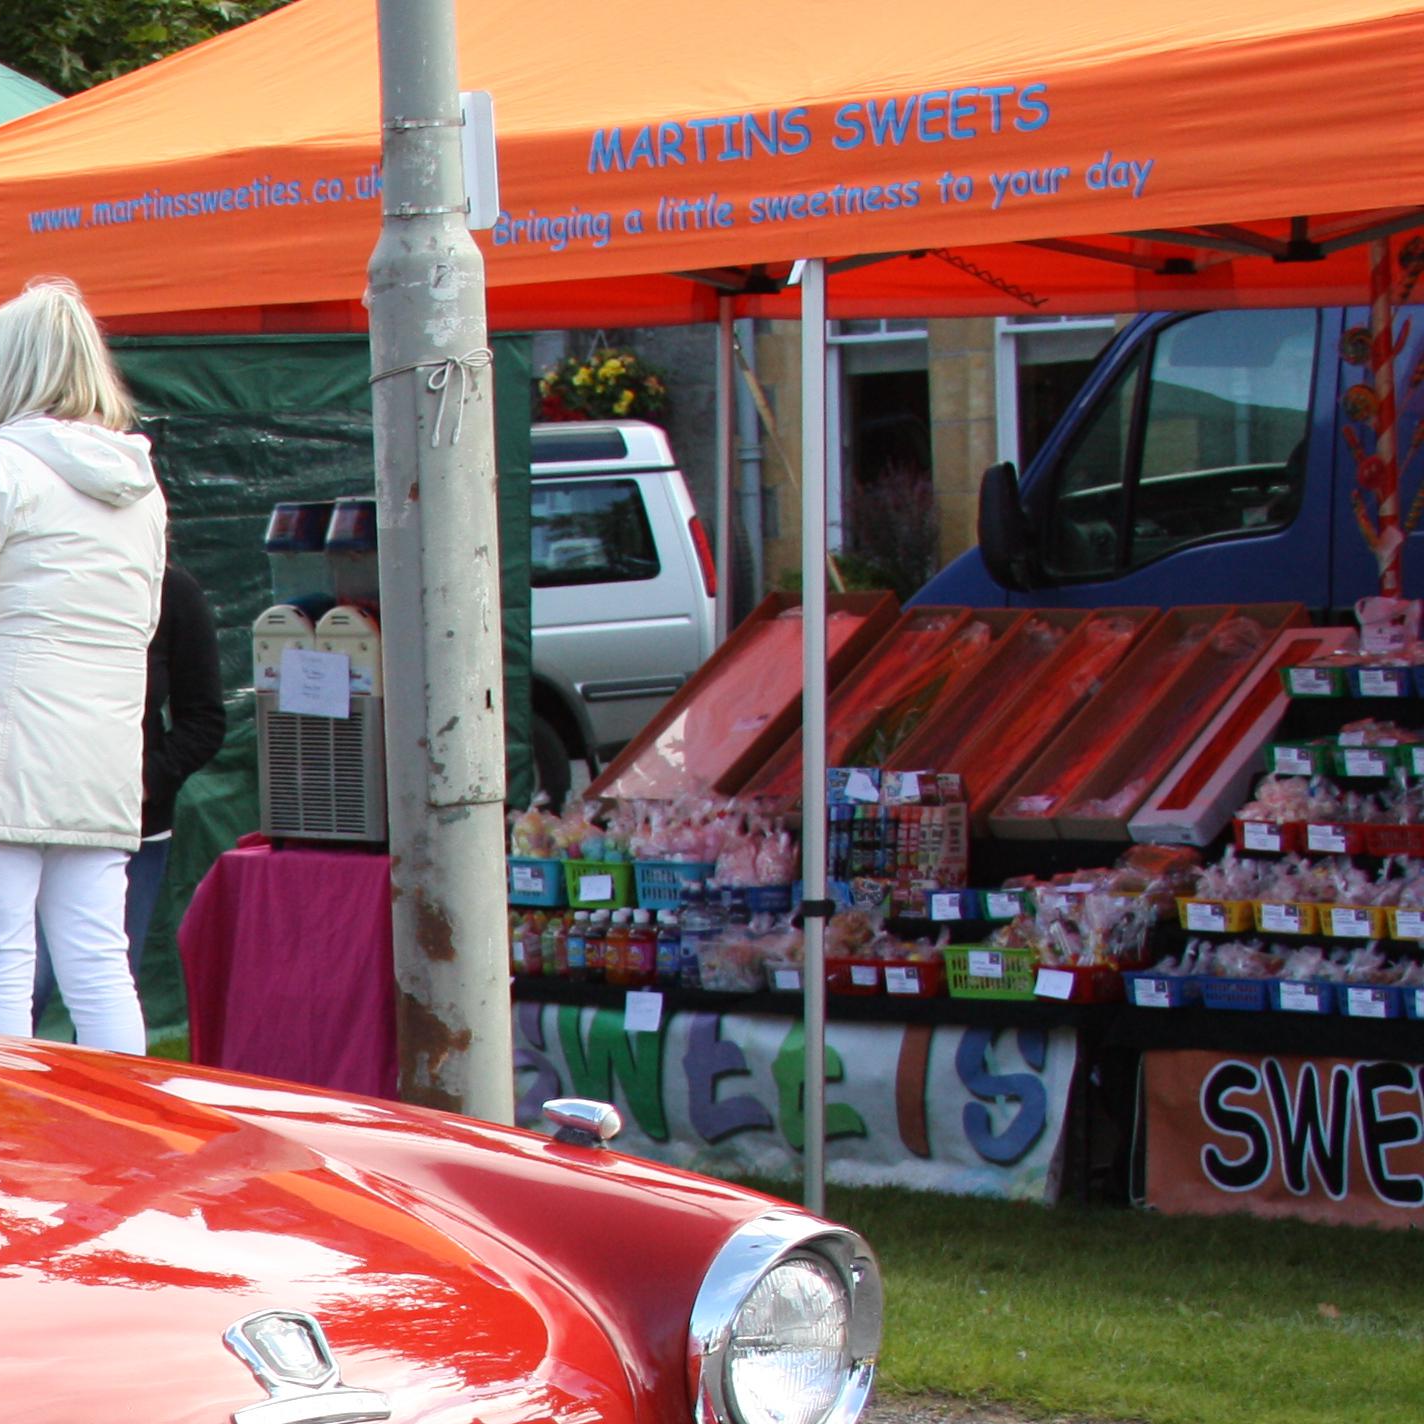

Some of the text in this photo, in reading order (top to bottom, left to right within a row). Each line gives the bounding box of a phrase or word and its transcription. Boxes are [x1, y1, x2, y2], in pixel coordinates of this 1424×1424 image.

[587, 82, 1051, 174] MARTINS SWEETS
[492, 149, 1155, 251] Bringing a little sweetness to your day
[1199, 1057, 1424, 1208] SWE
